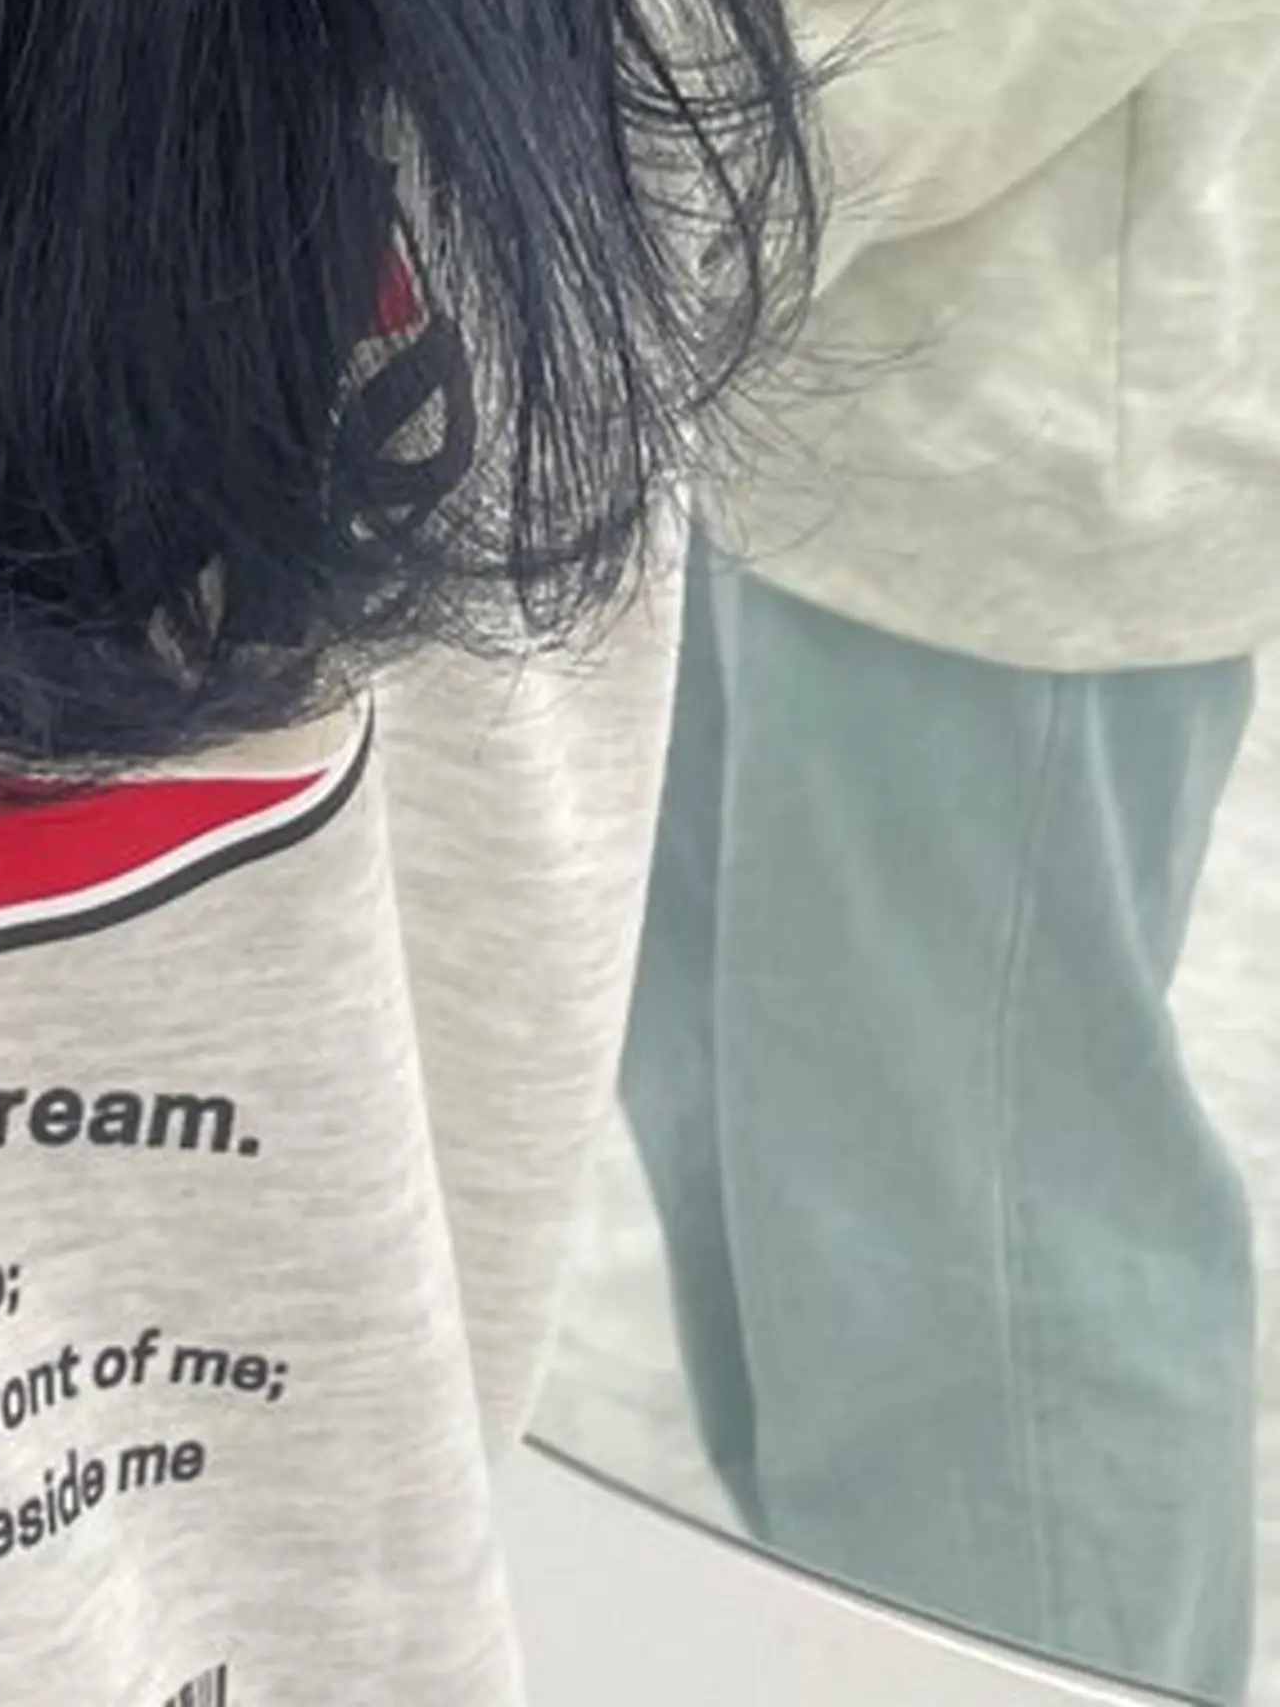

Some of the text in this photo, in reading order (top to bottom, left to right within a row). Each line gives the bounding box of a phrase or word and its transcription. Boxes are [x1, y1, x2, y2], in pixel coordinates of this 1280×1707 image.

[93, 1328, 161, 1388] of
[169, 1343, 290, 1403] me;
[117, 1439, 205, 1493] me
